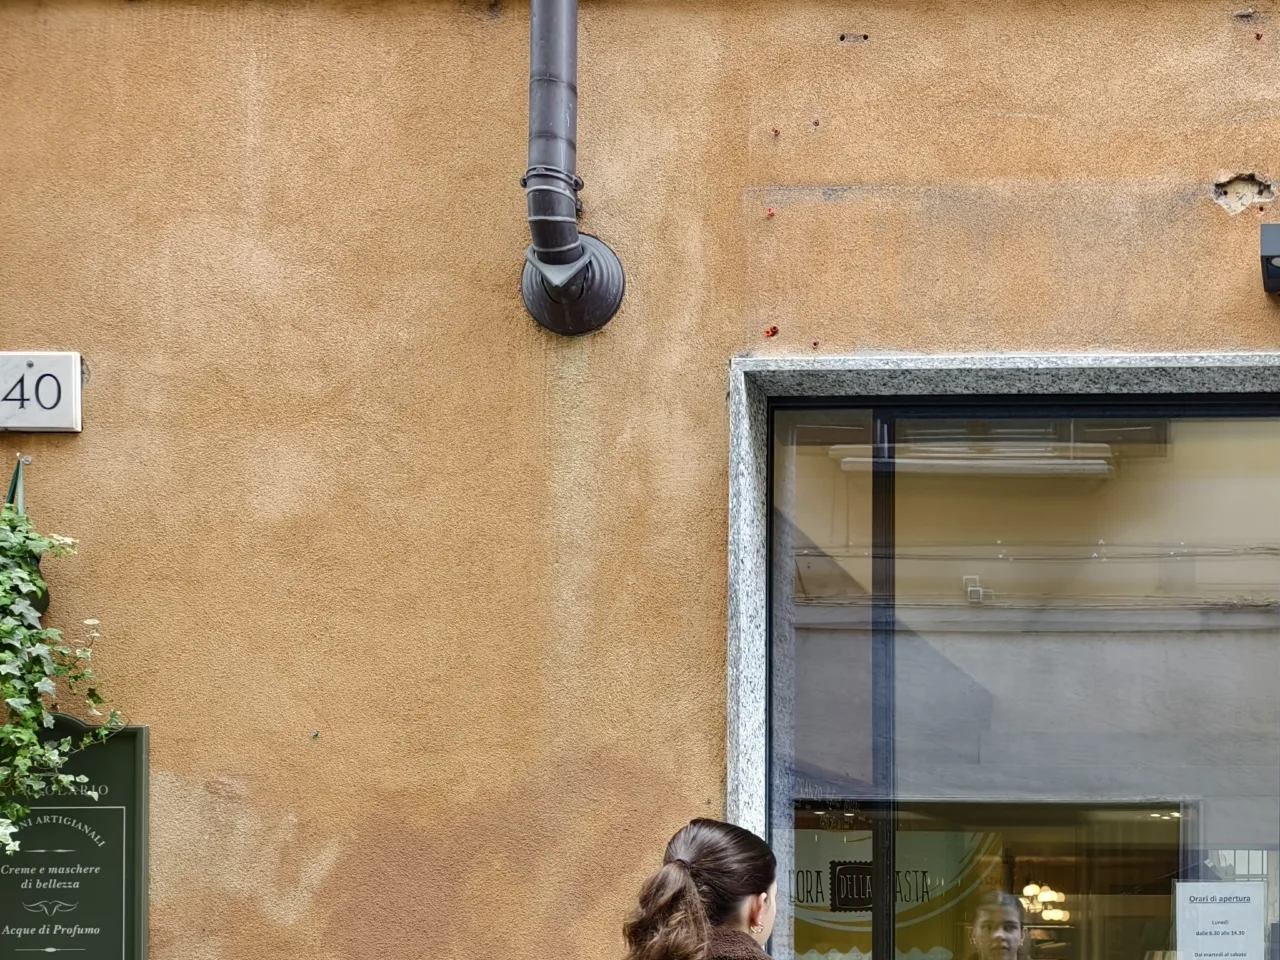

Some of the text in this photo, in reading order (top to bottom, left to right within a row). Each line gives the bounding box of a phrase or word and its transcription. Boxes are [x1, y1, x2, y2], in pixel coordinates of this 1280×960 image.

[1, 372, 62, 411] 40
[35, 815, 106, 848] ARTIGIANALI
[0, 863, 101, 875] Creme e maschere
[20, 878, 80, 889] di bellezza
[839, 874, 873, 899] DELLA
[895, 870, 930, 903] ASTA
[1189, 895, 1251, 904] Orari di apertura
[1, 924, 101, 938] Acque di Profumo
